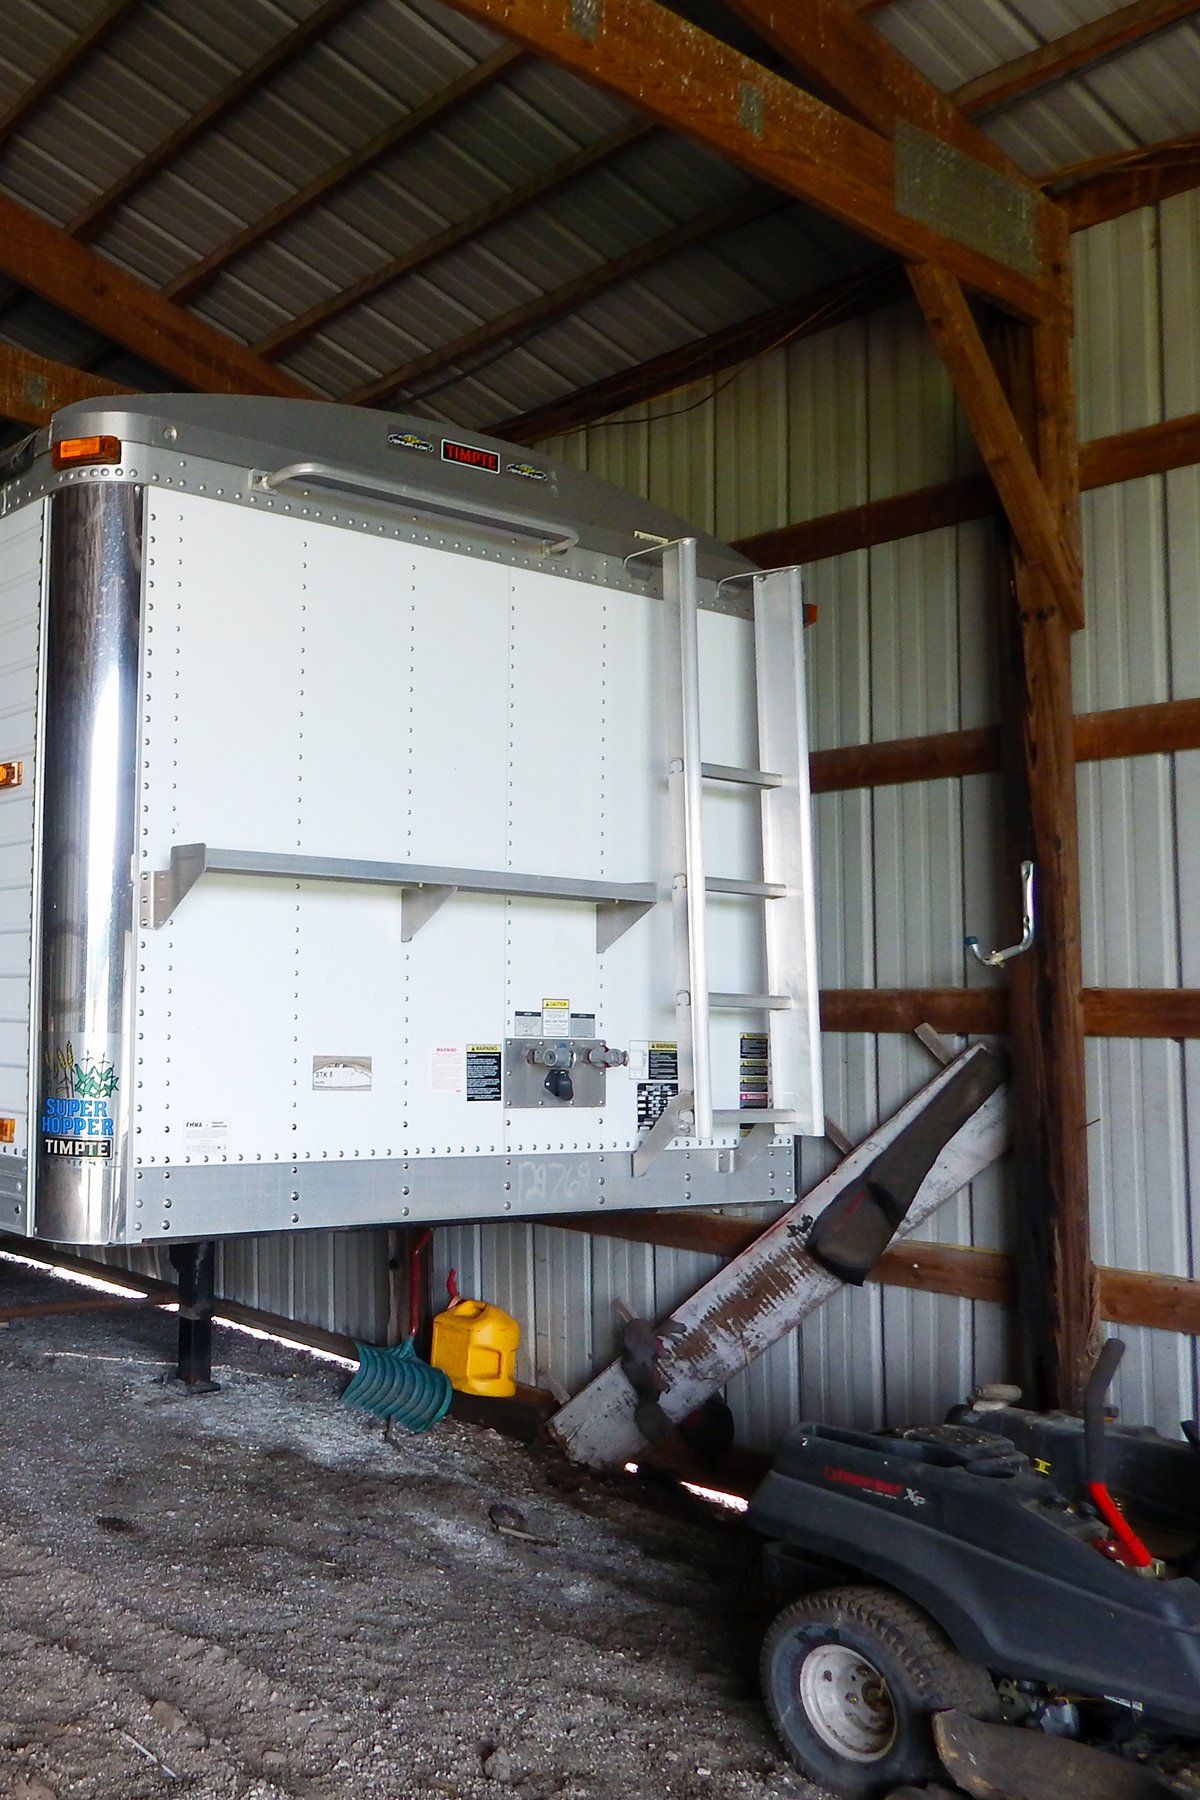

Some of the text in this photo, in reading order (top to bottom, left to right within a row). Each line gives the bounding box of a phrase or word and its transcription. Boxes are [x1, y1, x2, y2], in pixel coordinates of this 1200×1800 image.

[445, 444, 498, 469] TIMPTE
[46, 1097, 108, 1117] SUPER
[42, 1115, 114, 1136] HOPPER
[45, 1138, 108, 1156] TIMPTE
